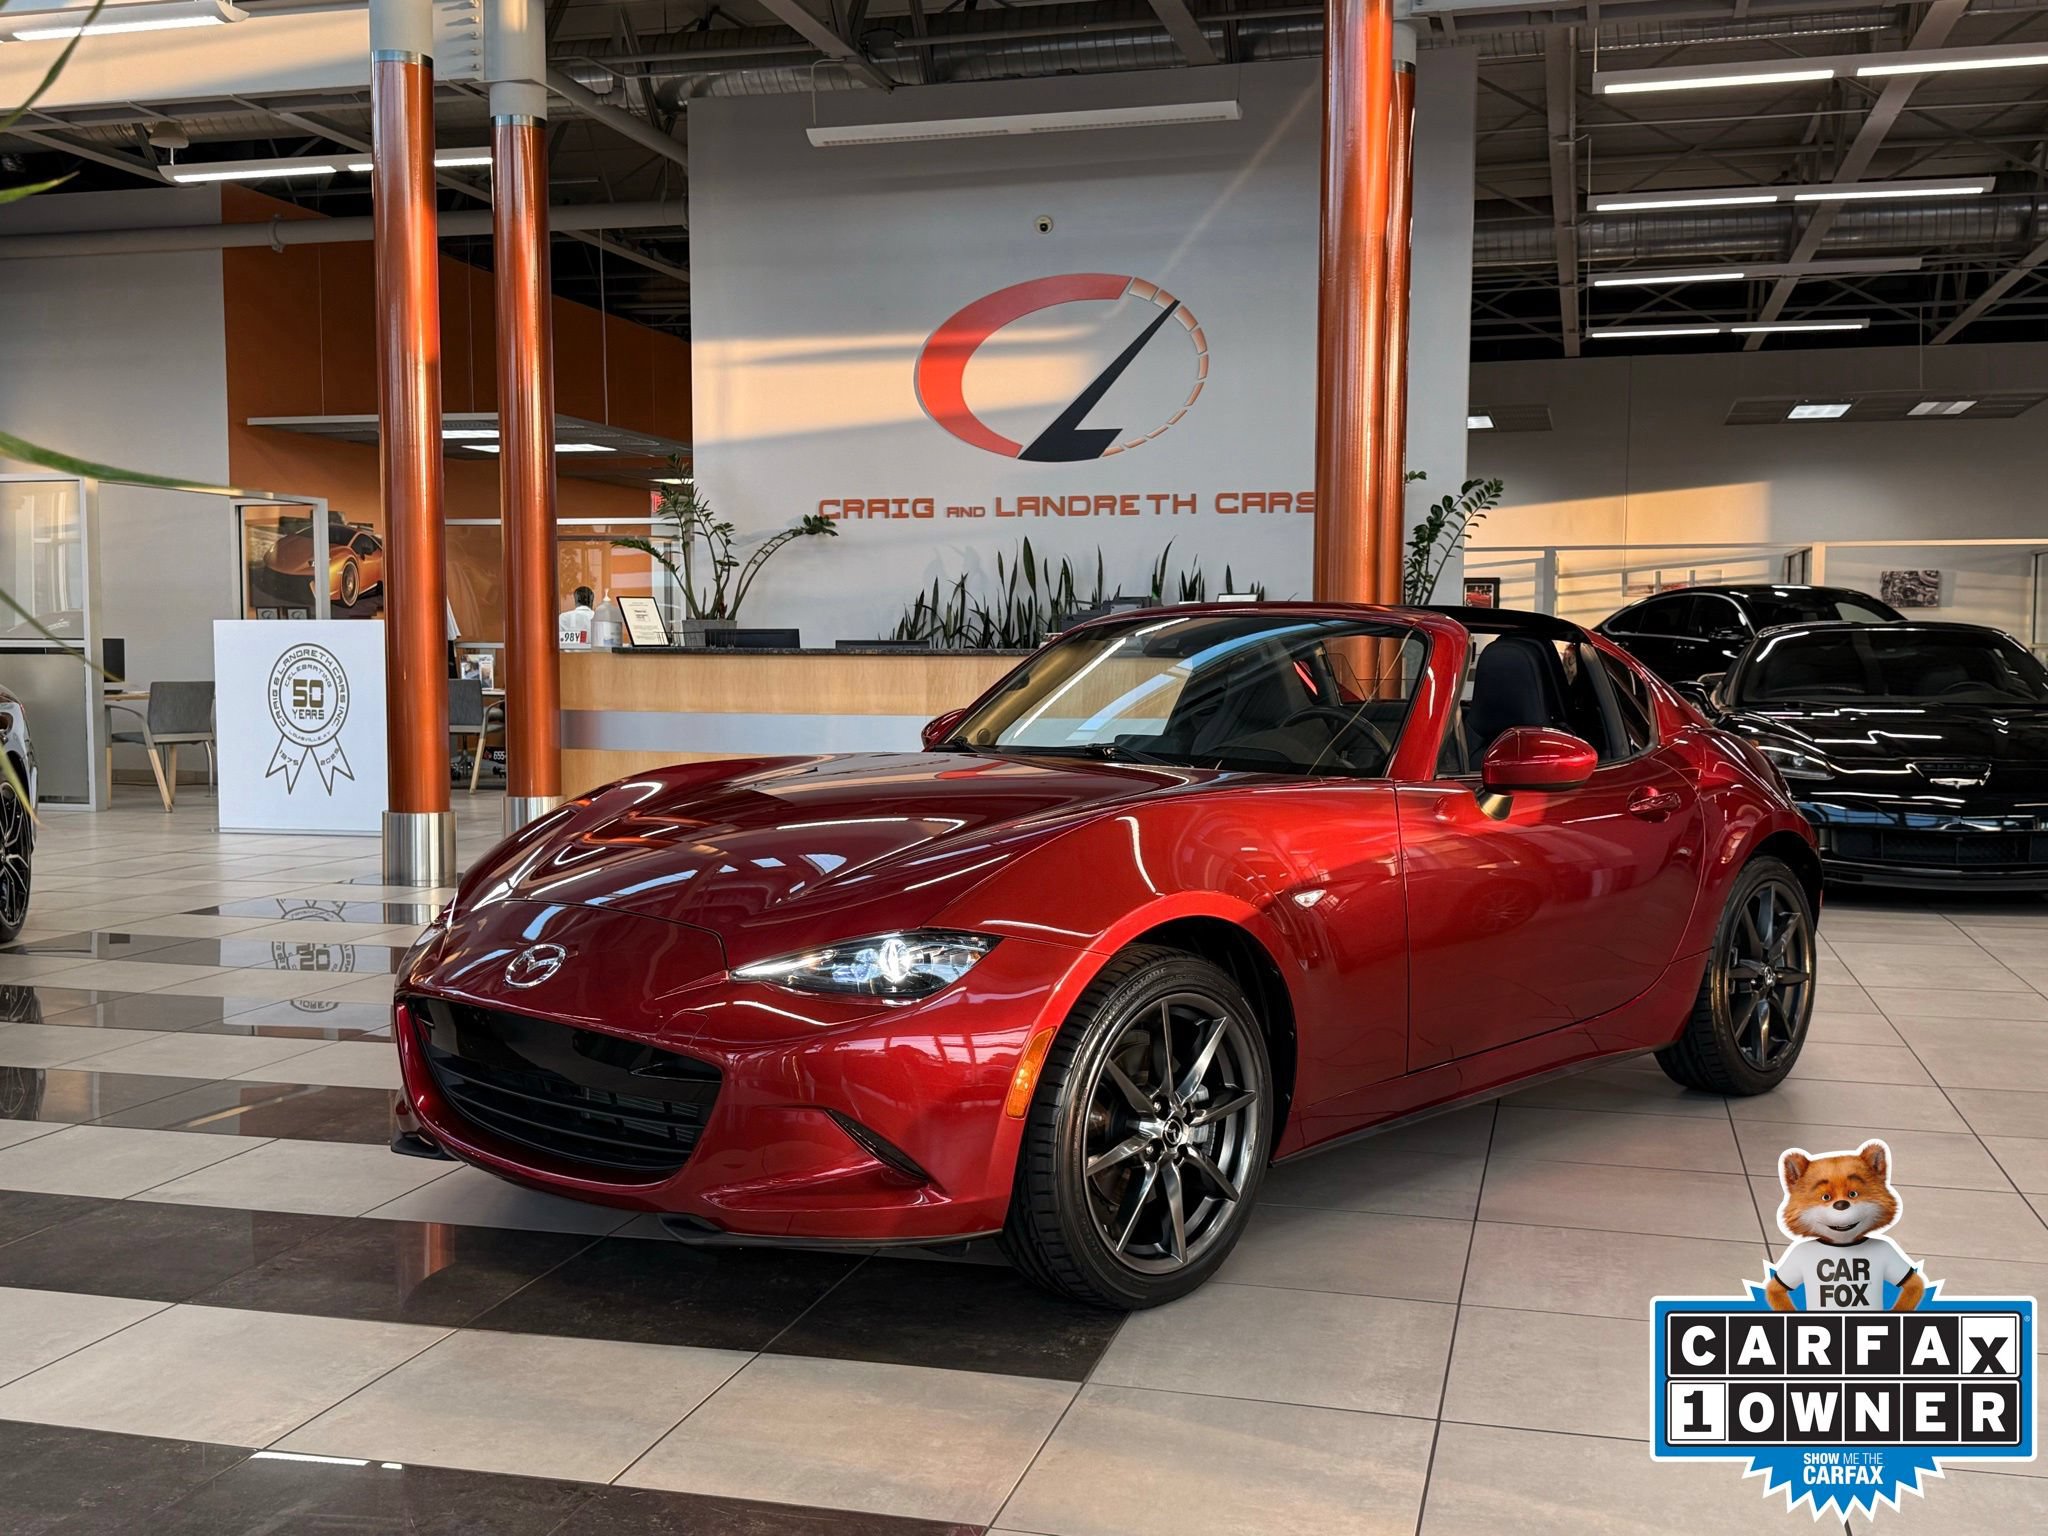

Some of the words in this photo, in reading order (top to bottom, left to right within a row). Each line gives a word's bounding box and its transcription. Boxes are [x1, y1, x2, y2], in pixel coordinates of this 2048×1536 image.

[818, 498, 934, 519] CRAIG
[946, 506, 986, 518] AND
[995, 494, 1196, 517] LANDRETH
[1215, 492, 1315, 514] CARS
[277, 649, 333, 675] LANDRETH
[332, 667, 346, 703] CARS
[284, 664, 332, 688] CELEBRATING
[293, 679, 324, 708] 50
[292, 709, 324, 720] YEARS
[279, 750, 299, 766] 1975
